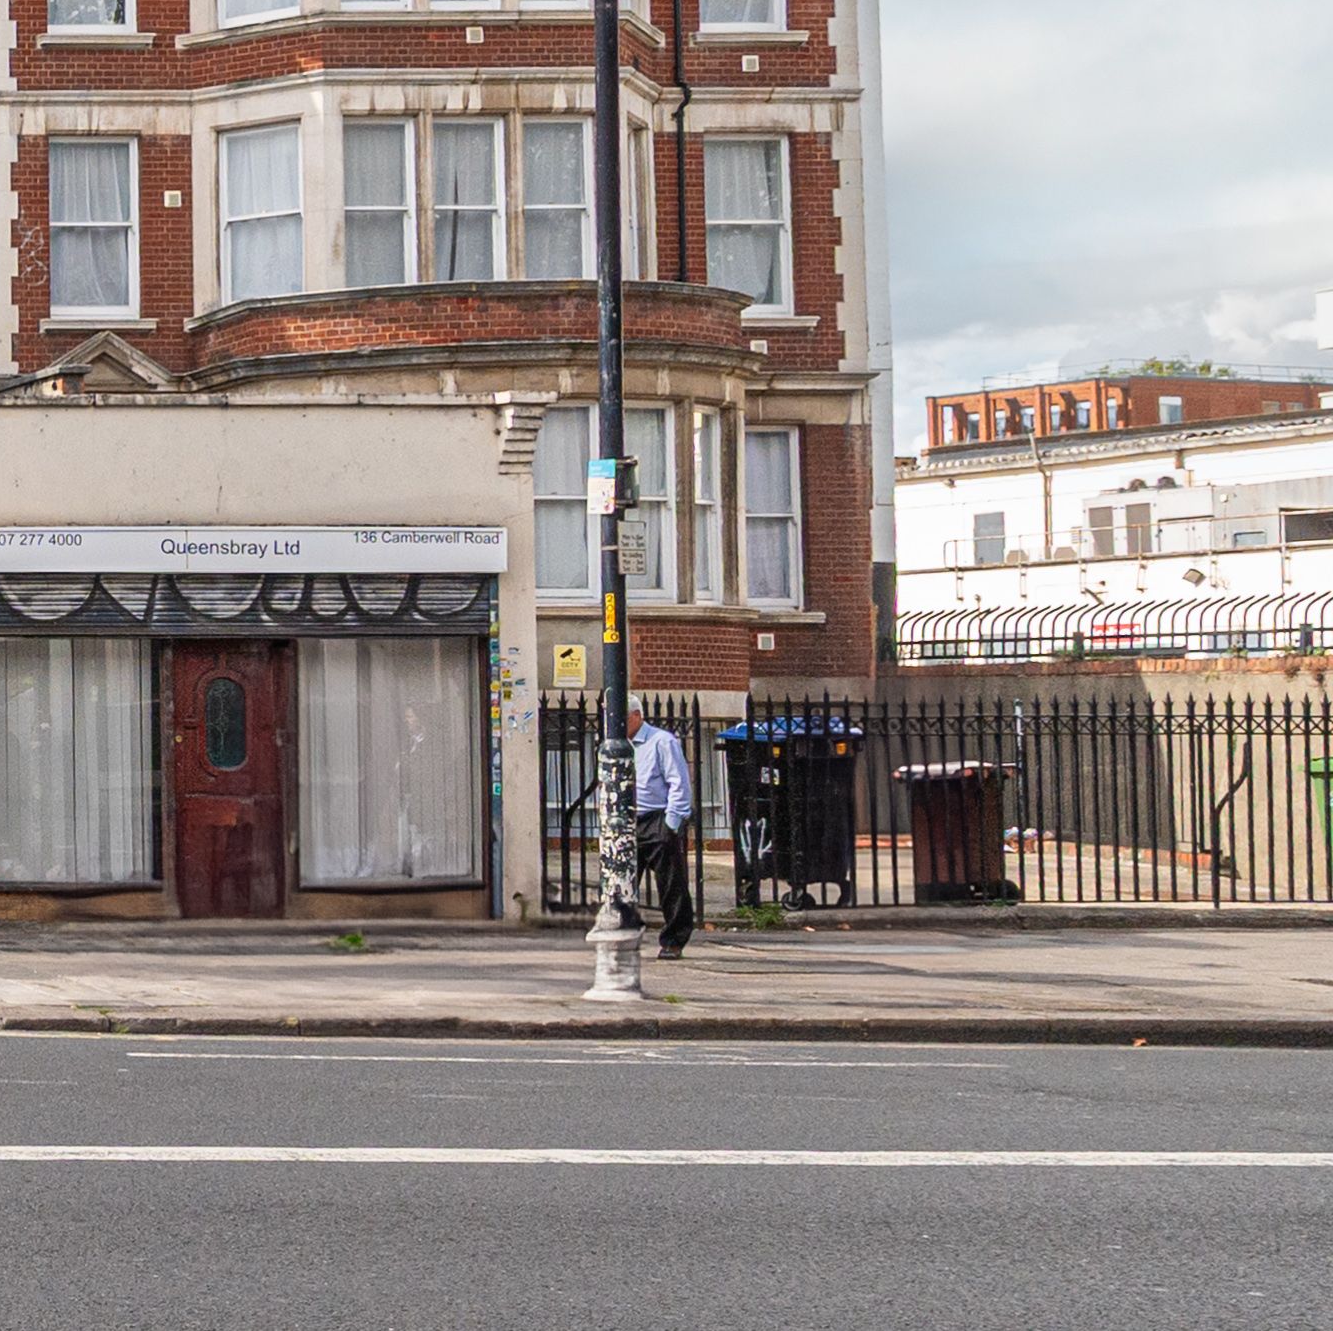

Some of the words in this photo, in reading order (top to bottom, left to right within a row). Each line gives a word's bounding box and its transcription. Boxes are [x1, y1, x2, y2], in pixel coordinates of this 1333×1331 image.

[19, 533, 44, 546] 277
[48, 533, 82, 546] 4000
[354, 531, 377, 543] 136
[381, 531, 459, 543] Camberwell
[464, 531, 500, 544] Road
[160, 539, 268, 558] Queensbray
[273, 539, 300, 555] Ltd
